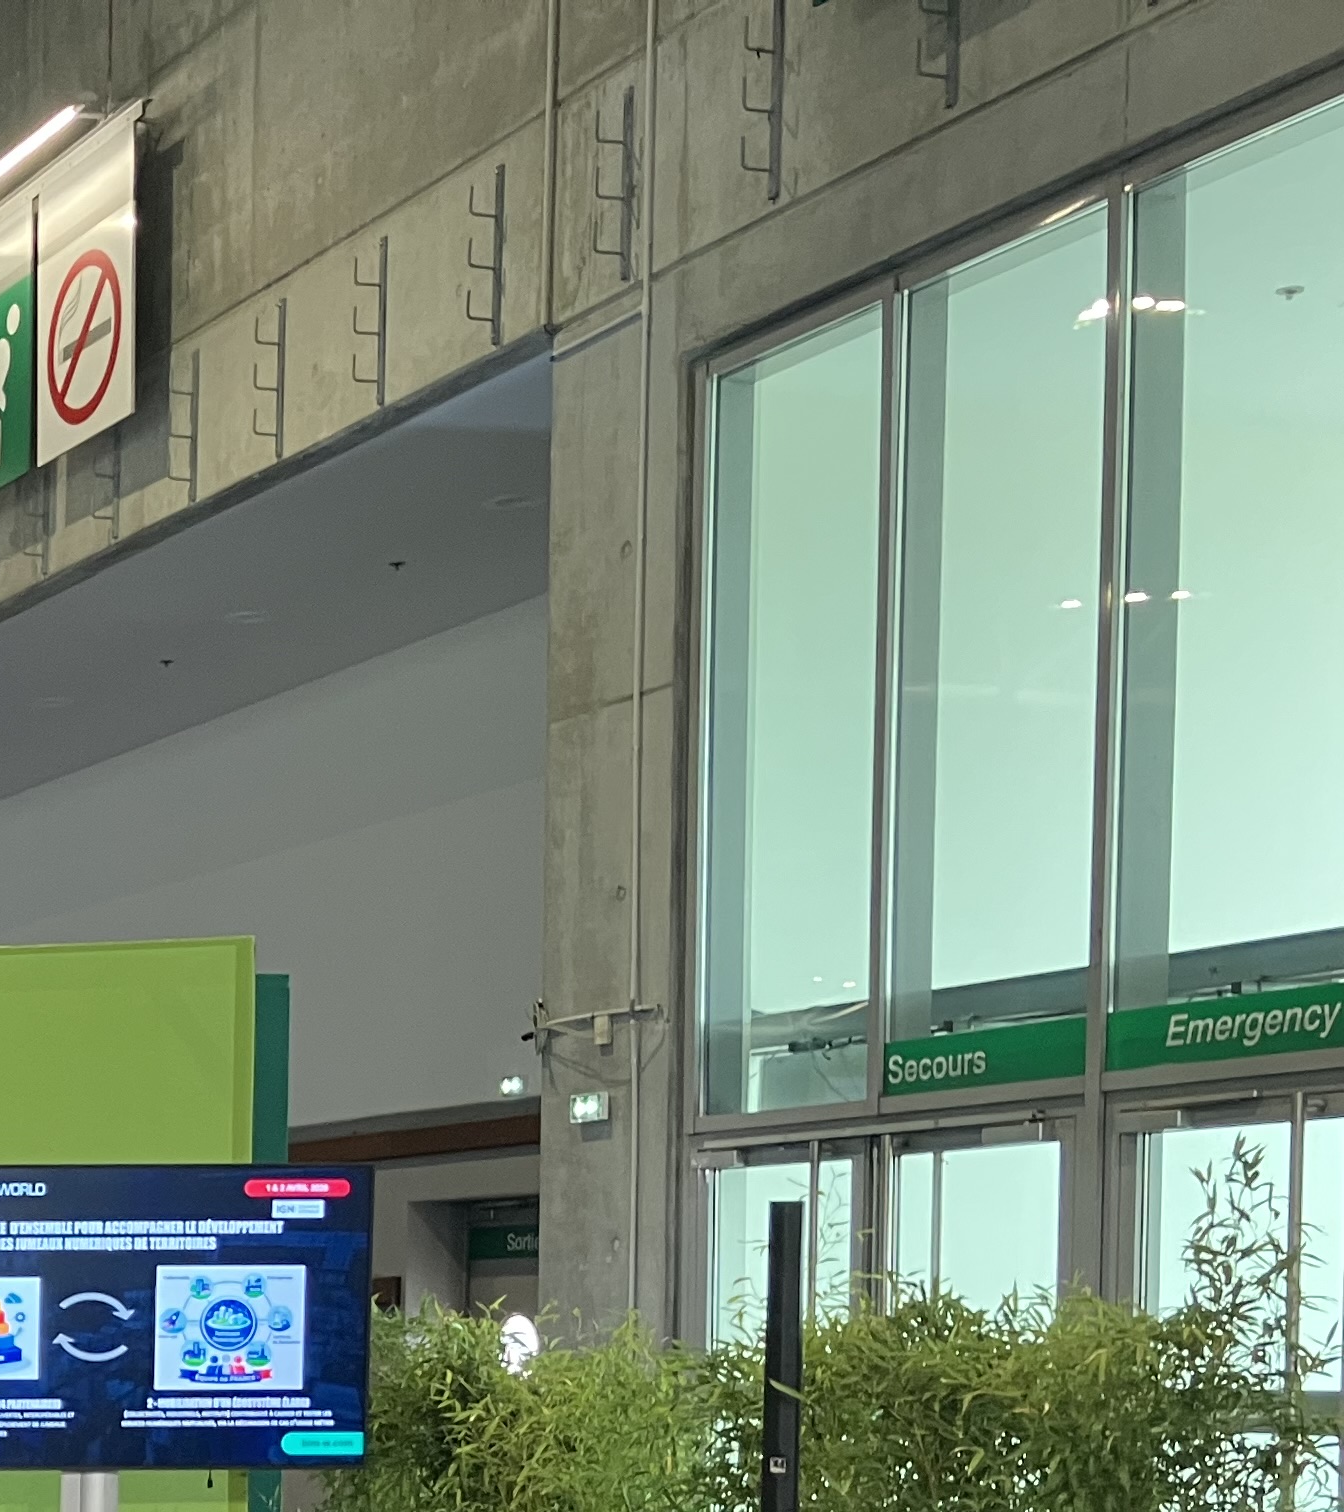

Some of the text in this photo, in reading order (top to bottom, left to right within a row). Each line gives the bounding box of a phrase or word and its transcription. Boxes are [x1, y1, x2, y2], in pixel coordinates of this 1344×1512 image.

[1165, 1000, 1343, 1048] Emergency
[887, 1049, 987, 1084] Secours
[74, 1221, 103, 1235] POUR
[103, 1220, 184, 1234] ACCOMPAGNER
[14, 1237, 63, 1251] JUMEAUX
